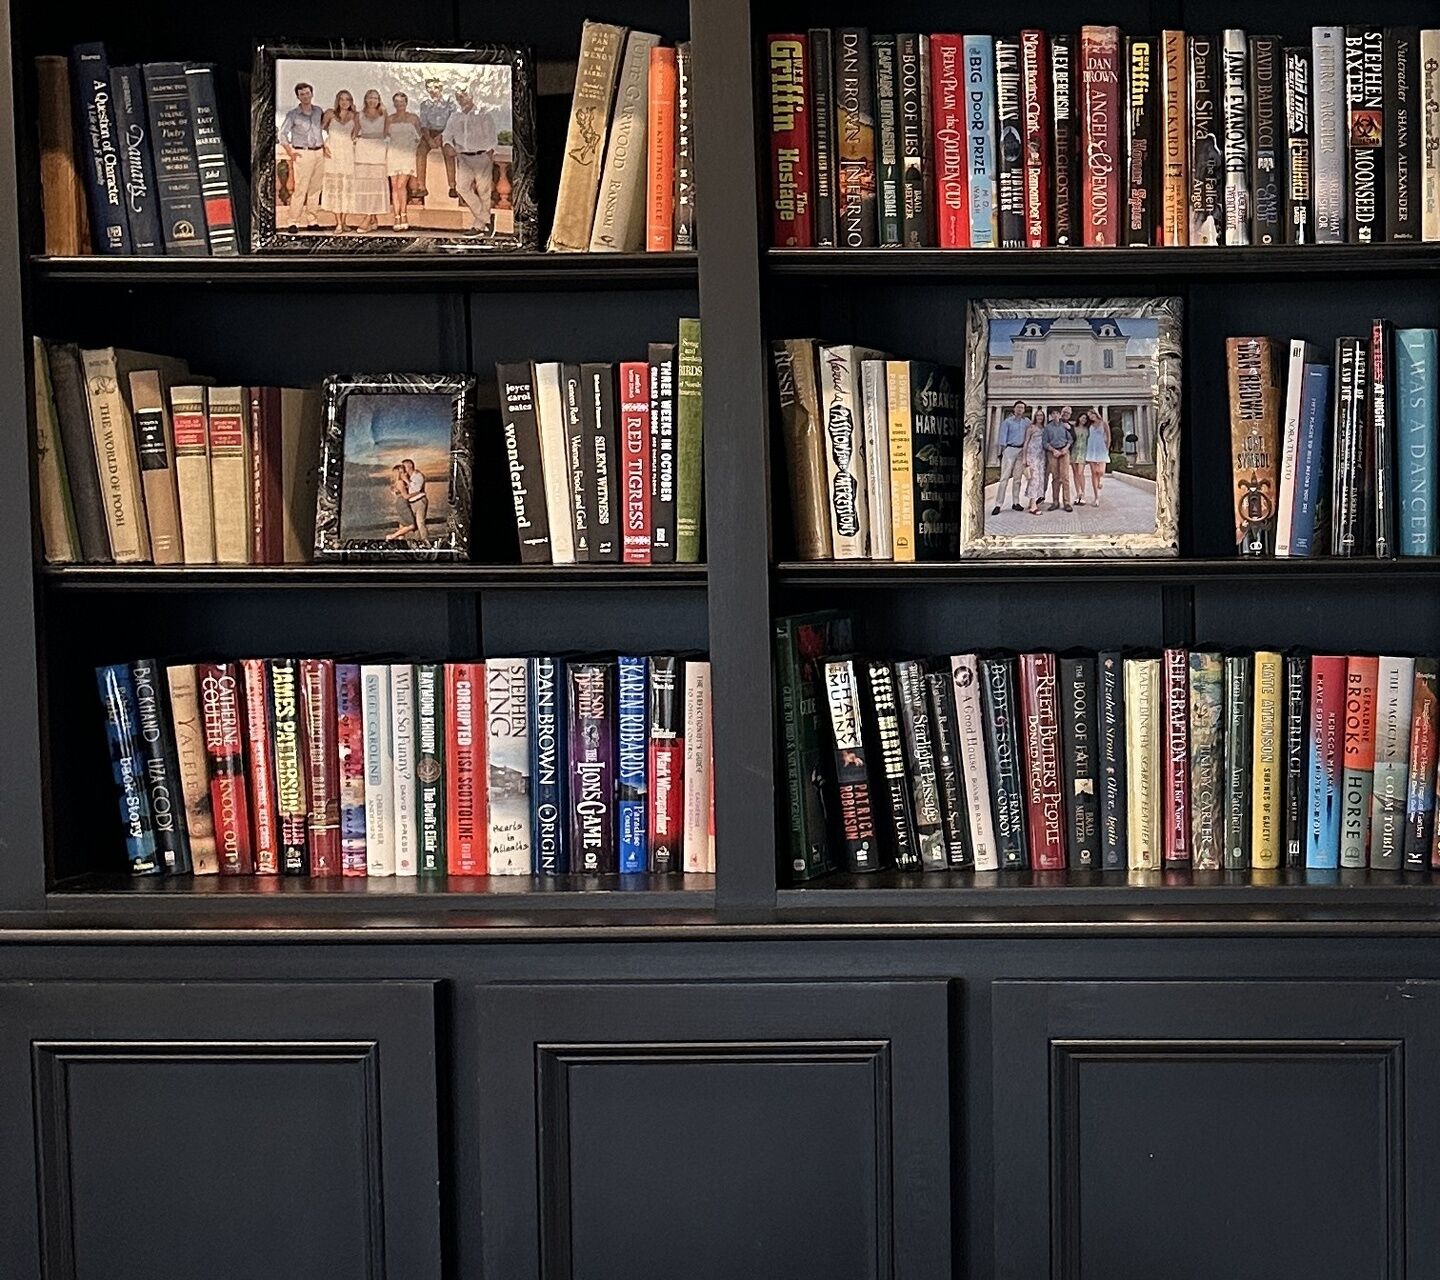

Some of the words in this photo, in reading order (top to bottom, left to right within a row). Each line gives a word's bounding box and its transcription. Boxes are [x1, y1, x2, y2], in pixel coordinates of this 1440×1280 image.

[843, 33, 858, 72] DAN
[970, 55, 982, 83] BIG
[1131, 42, 1149, 107] Griffin
[1167, 36, 1177, 84] NANCY
[1194, 41, 1210, 93] Daniel
[1257, 40, 1272, 80] DAVID
[1345, 36, 1363, 105] BAXTER
[1364, 32, 1383, 108] STEPHEN
[1396, 39, 1408, 102] Nutcracker
[93, 79, 104, 90] A
[770, 40, 803, 132] Griffin
[95, 92, 113, 138] Question
[845, 78, 860, 143] BROWN
[971, 91, 983, 130] DOOR
[1167, 90, 1178, 156] PICKARD
[1195, 99, 1212, 140] Silva
[1258, 83, 1275, 148] BALDACCI
[1398, 108, 1407, 148] SHANA
[103, 140, 116, 151] of
[973, 136, 985, 175] PRIZE
[104, 153, 120, 206] Character
[840, 160, 866, 247] INFERNO
[1191, 178, 1203, 212] Angel
[1354, 148, 1375, 222] MOONSEED
[1398, 152, 1407, 222] ALEXANDER
[661, 360, 671, 396] THREE
[1409, 359, 1426, 408] WAS
[99, 402, 111, 429] THE
[627, 416, 642, 453] RED
[661, 399, 672, 435] WEEKS
[1410, 418, 1426, 432] A
[104, 431, 117, 473] WORLD
[595, 435, 607, 473] SILENT
[661, 438, 671, 450] IN
[110, 476, 120, 491] OF
[505, 422, 530, 529] wonderland
[596, 475, 609, 524] WITNESS
[629, 458, 643, 529] TIGRESS
[660, 452, 672, 501] OCTOBER
[1410, 443, 1426, 545] DANCER
[113, 493, 125, 527] POOH
[133, 666, 160, 742] BACKHAND
[273, 666, 296, 717] JAMES
[368, 676, 379, 717] SWEET
[395, 671, 410, 714] What's
[489, 666, 510, 737] KING
[511, 665, 527, 737] STEPHEN
[538, 664, 554, 706] DAN
[621, 664, 644, 708] KAREN
[829, 673, 847, 745] MUTINY
[840, 673, 858, 743] SHARK
[1105, 669, 1115, 724] Elizabeth
[218, 675, 238, 746] CATHERINE
[398, 716, 409, 733] So
[457, 680, 472, 745] CORRUPTED
[1345, 673, 1361, 754] BROOKS
[1362, 686, 1371, 743] GERALDINE
[276, 720, 300, 811] PATTERSON
[368, 720, 380, 781] CAROLINE
[395, 734, 410, 780] Funny?
[538, 712, 555, 784] BROWN
[621, 713, 644, 777] ROBARDS
[913, 714, 930, 769] Starlight
[1106, 725, 1115, 761] Strout
[147, 757, 165, 783] LIZA
[152, 784, 173, 833] CODY
[890, 783, 902, 811] THE
[919, 772, 939, 822] Passage
[996, 788, 1009, 837] CONROY
[1009, 791, 1021, 832] FRANK
[1346, 776, 1361, 840] HORSE
[623, 807, 637, 845] County
[634, 805, 644, 847] Paradise
[895, 814, 908, 847] JURY
